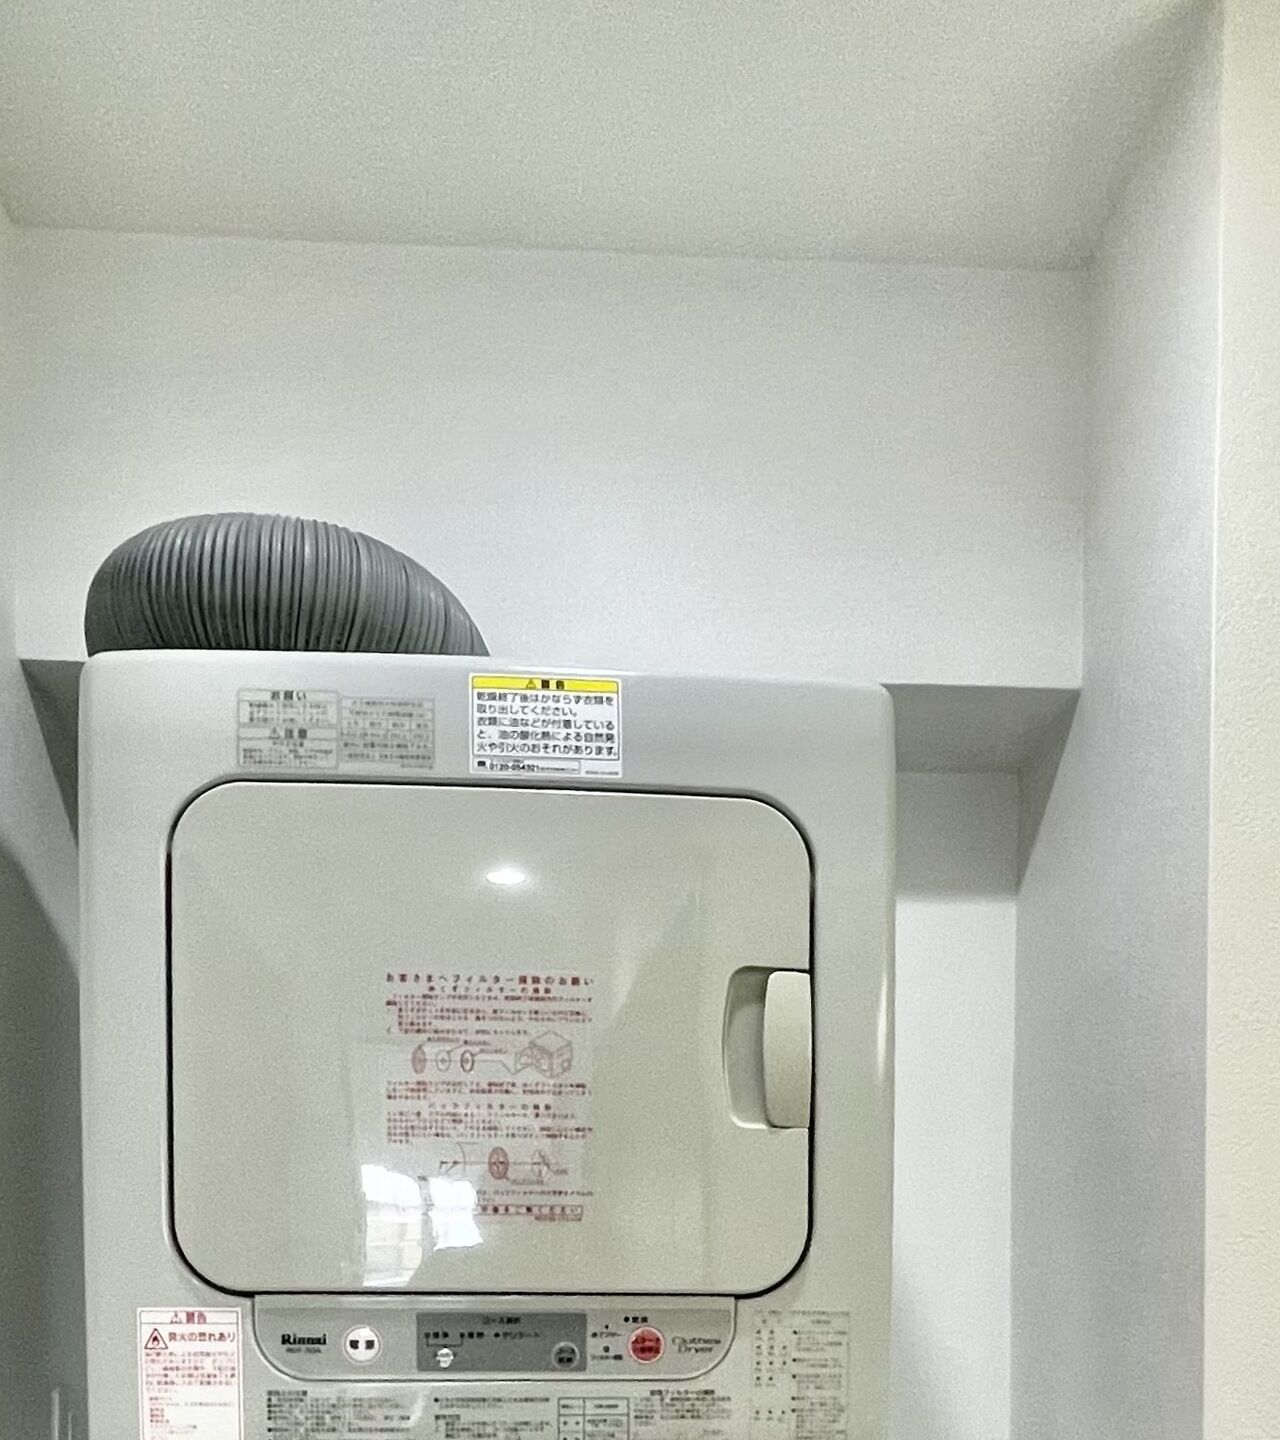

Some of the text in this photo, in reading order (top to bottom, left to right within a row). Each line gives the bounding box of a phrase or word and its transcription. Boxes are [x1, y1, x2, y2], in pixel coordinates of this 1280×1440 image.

[477, 703, 578, 717] 取り出してください。
[477, 743, 618, 756] 火や引火のおそれがあります。
[168, 1332, 236, 1343] 発火の恐れあり
[281, 1333, 327, 1345] Rinnai
[678, 1344, 713, 1354] Dryer
